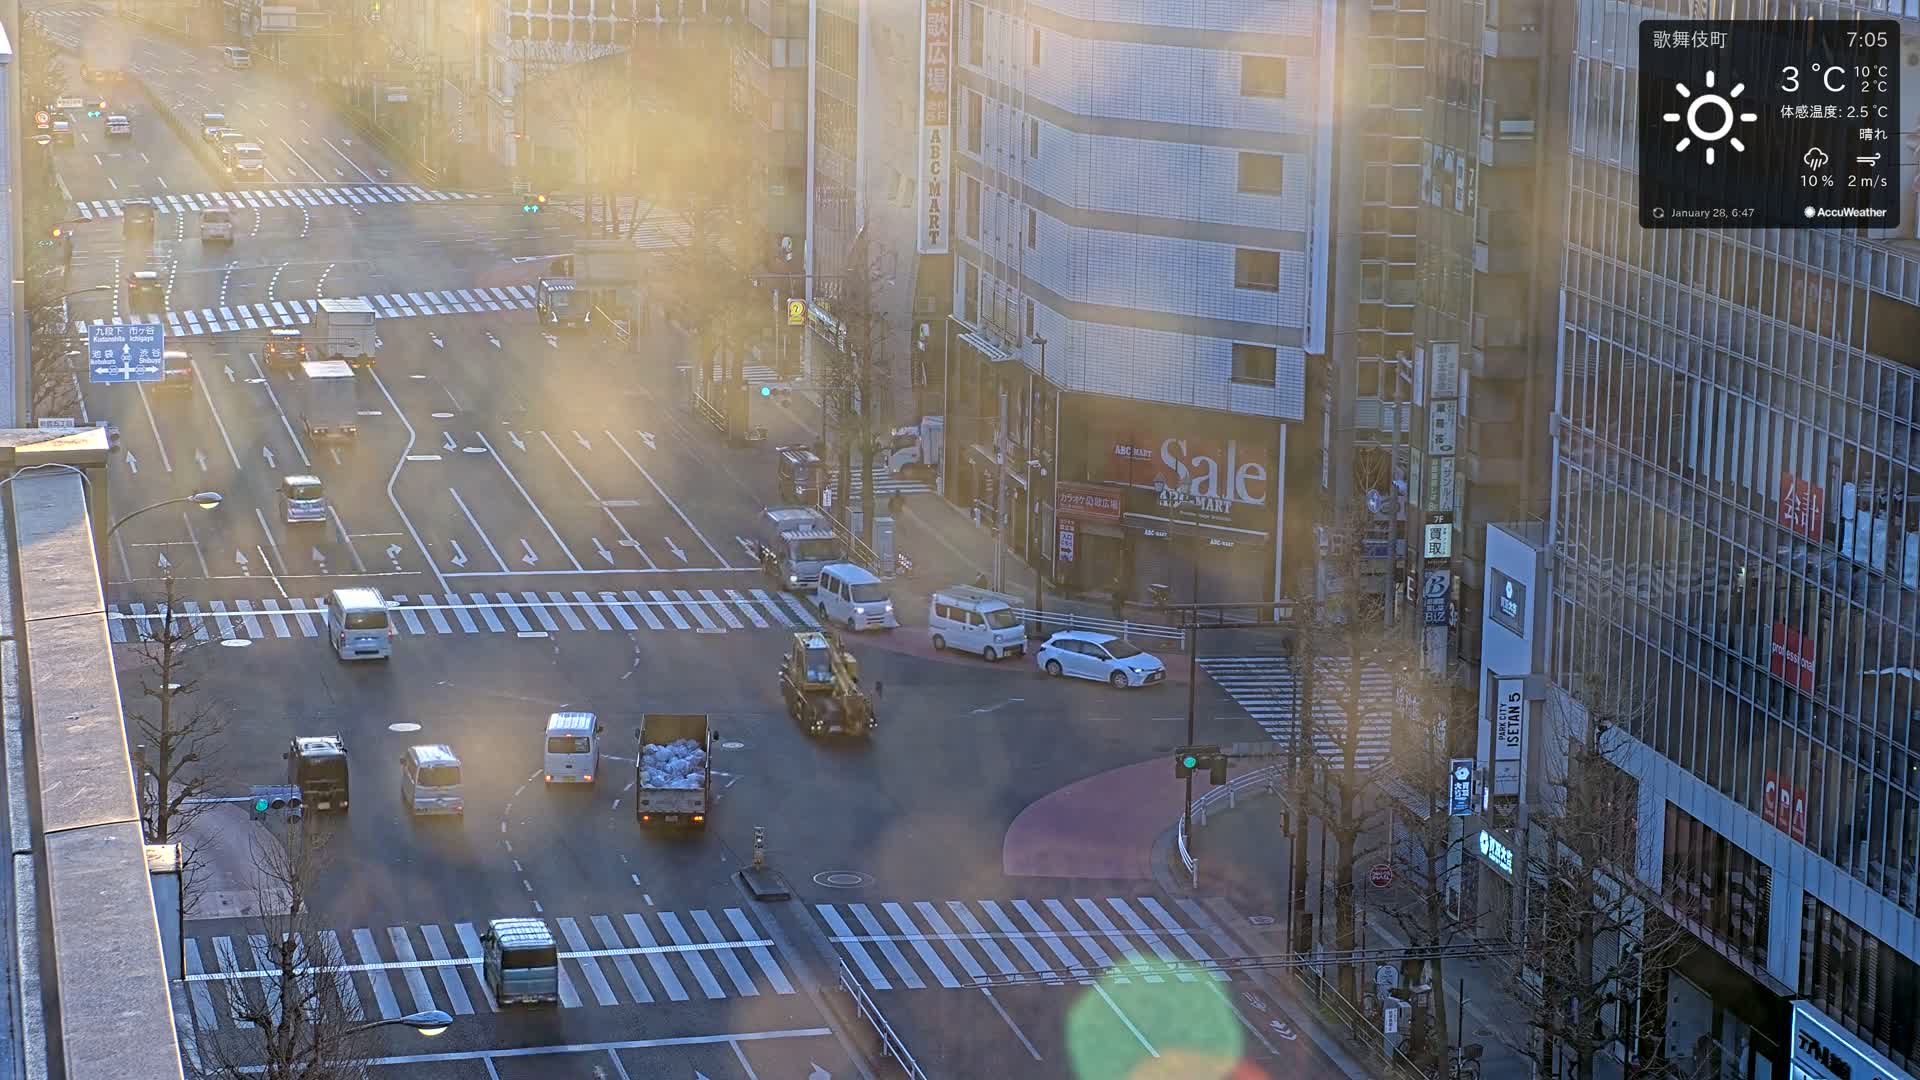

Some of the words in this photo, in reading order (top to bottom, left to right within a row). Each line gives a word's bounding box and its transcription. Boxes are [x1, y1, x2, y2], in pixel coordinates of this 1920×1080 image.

[1115, 445, 1153, 458] ABCMART
[1160, 438, 1267, 505] Sale
[1429, 527, 1442, 555] 買取
[1508, 692, 1521, 703] 5
[1499, 703, 1508, 720] CITY
[1498, 719, 1508, 741] PARK
[1507, 705, 1520, 747] ISETAN
